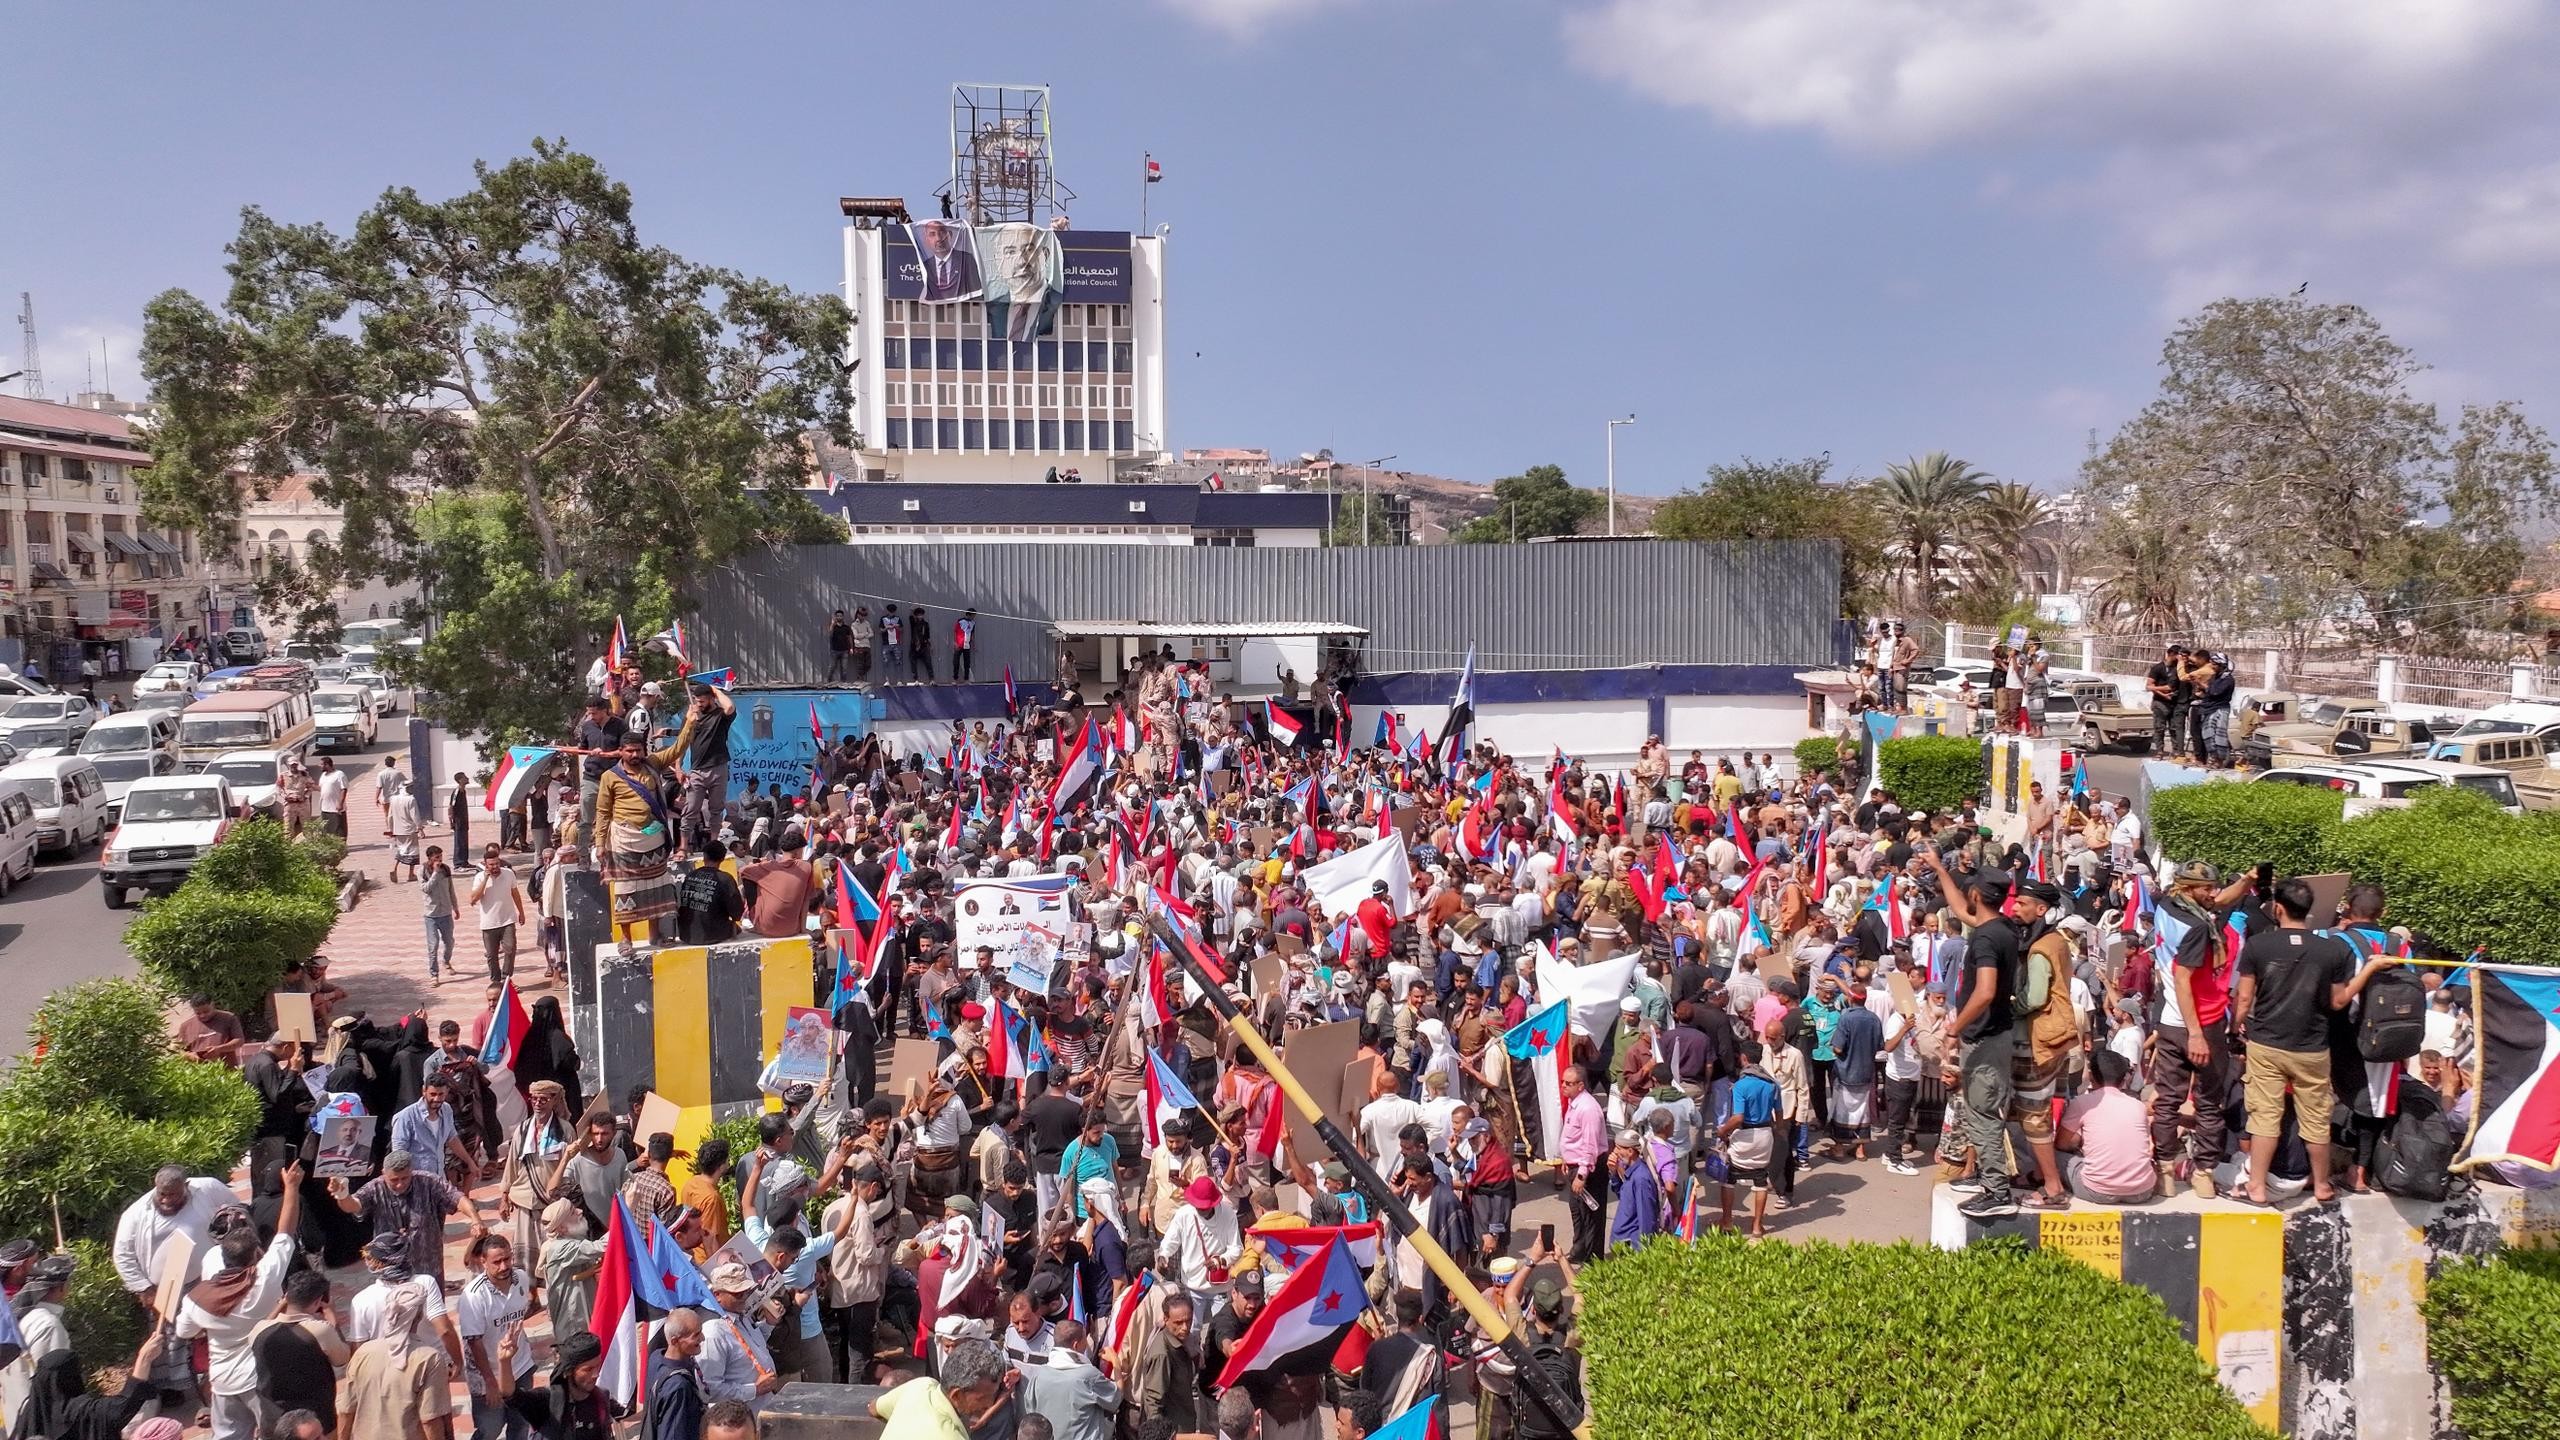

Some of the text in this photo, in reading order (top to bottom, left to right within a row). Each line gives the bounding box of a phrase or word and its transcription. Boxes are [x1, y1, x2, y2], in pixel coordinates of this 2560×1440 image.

[1079, 266, 1118, 277] الجمعية
[733, 758, 799, 771] SANDWICH
[768, 771, 800, 787] CHIPS
[976, 923, 995, 935] الواقع
